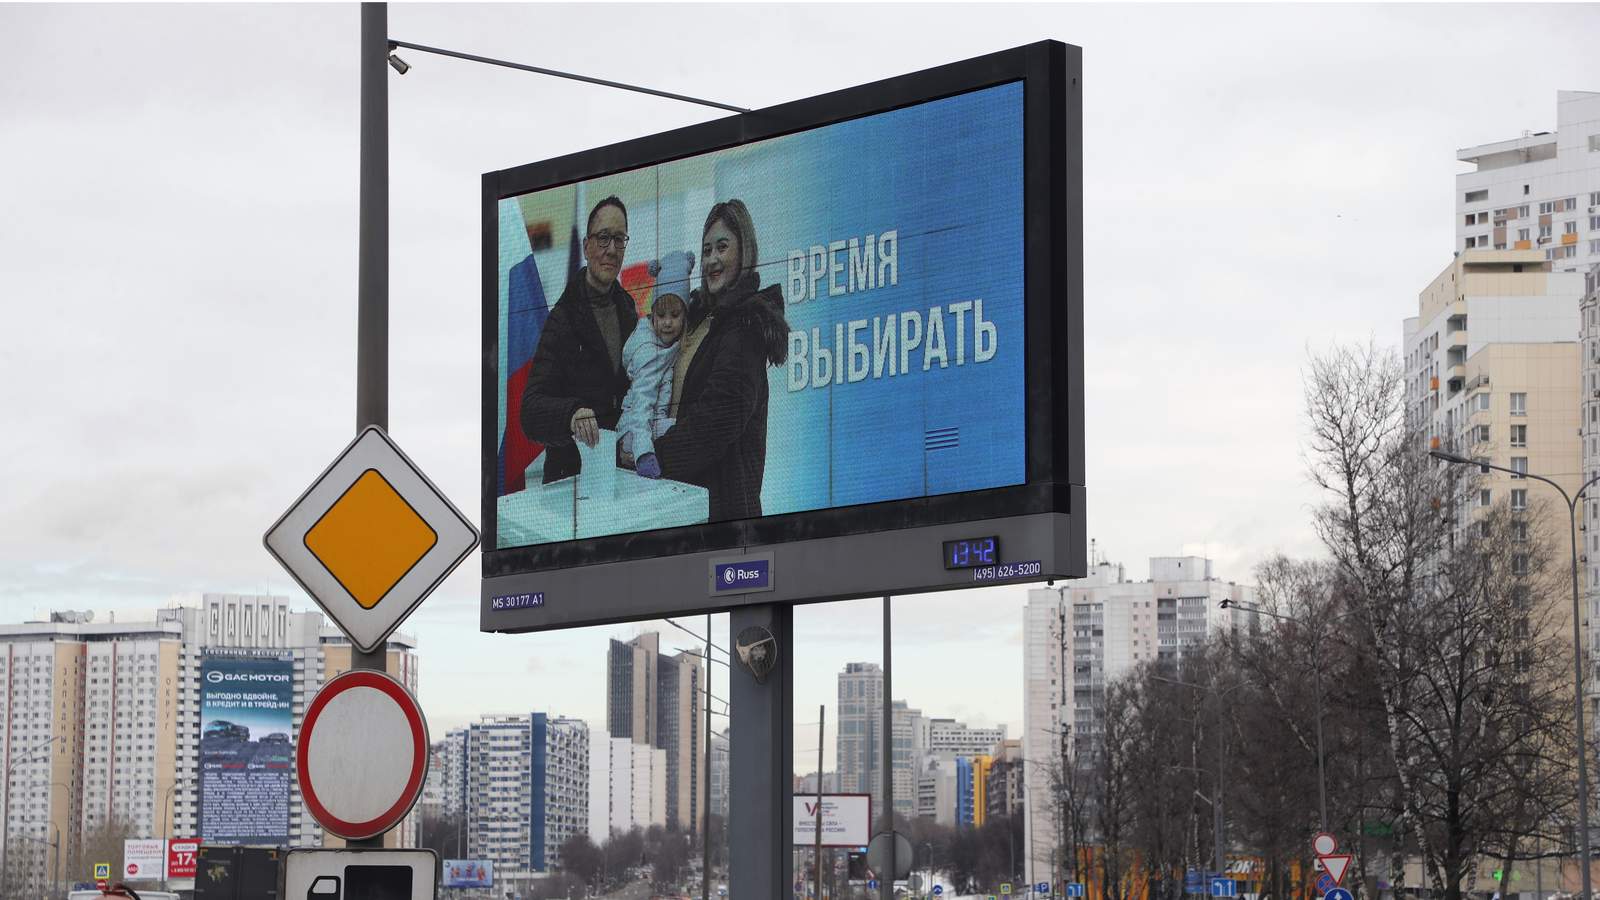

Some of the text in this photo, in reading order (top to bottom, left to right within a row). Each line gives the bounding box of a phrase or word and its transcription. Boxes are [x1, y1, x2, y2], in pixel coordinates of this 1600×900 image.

[787, 229, 898, 304] ВРЕМЯ
[787, 299, 998, 393] ВЫБИРАТЬ
[737, 569, 759, 580] Russ
[973, 562, 1041, 581] (495) 626-5200
[492, 593, 543, 609] MS 30177 A1
[225, 673, 290, 682] GAC MOTOR
[206, 692, 242, 701] ВЫГОДНО
[212, 700, 240, 709] КРЕДИТ
[254, 701, 290, 710] ТРЕЙД-ИН
